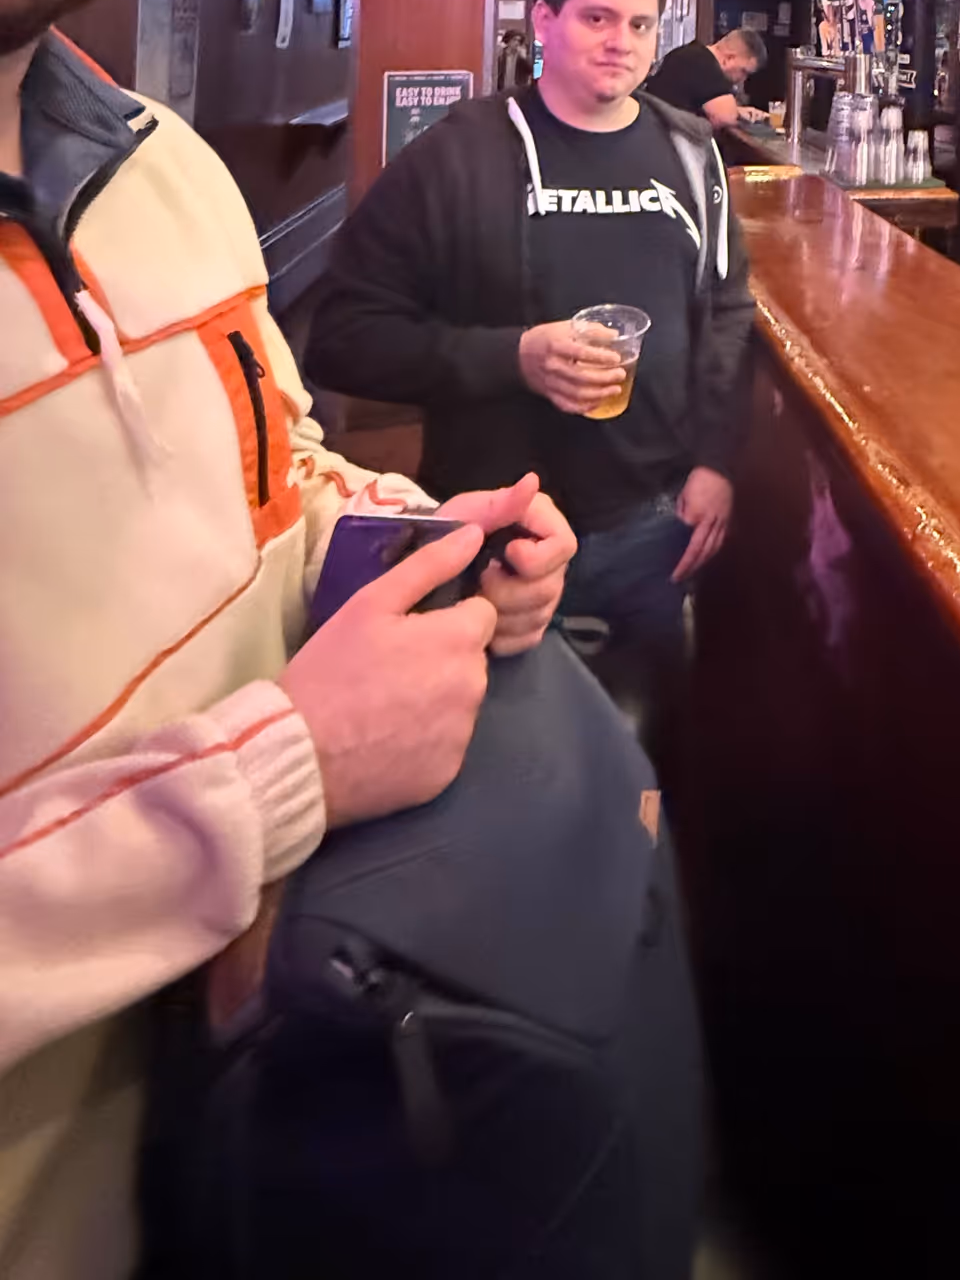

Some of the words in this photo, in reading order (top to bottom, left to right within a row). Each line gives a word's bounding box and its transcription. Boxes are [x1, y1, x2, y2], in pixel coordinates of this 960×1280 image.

[396, 86, 419, 96] EASY
[421, 87, 433, 96] TO
[434, 86, 462, 96] DRINK
[395, 96, 419, 107] EASY
[420, 96, 432, 106] TO
